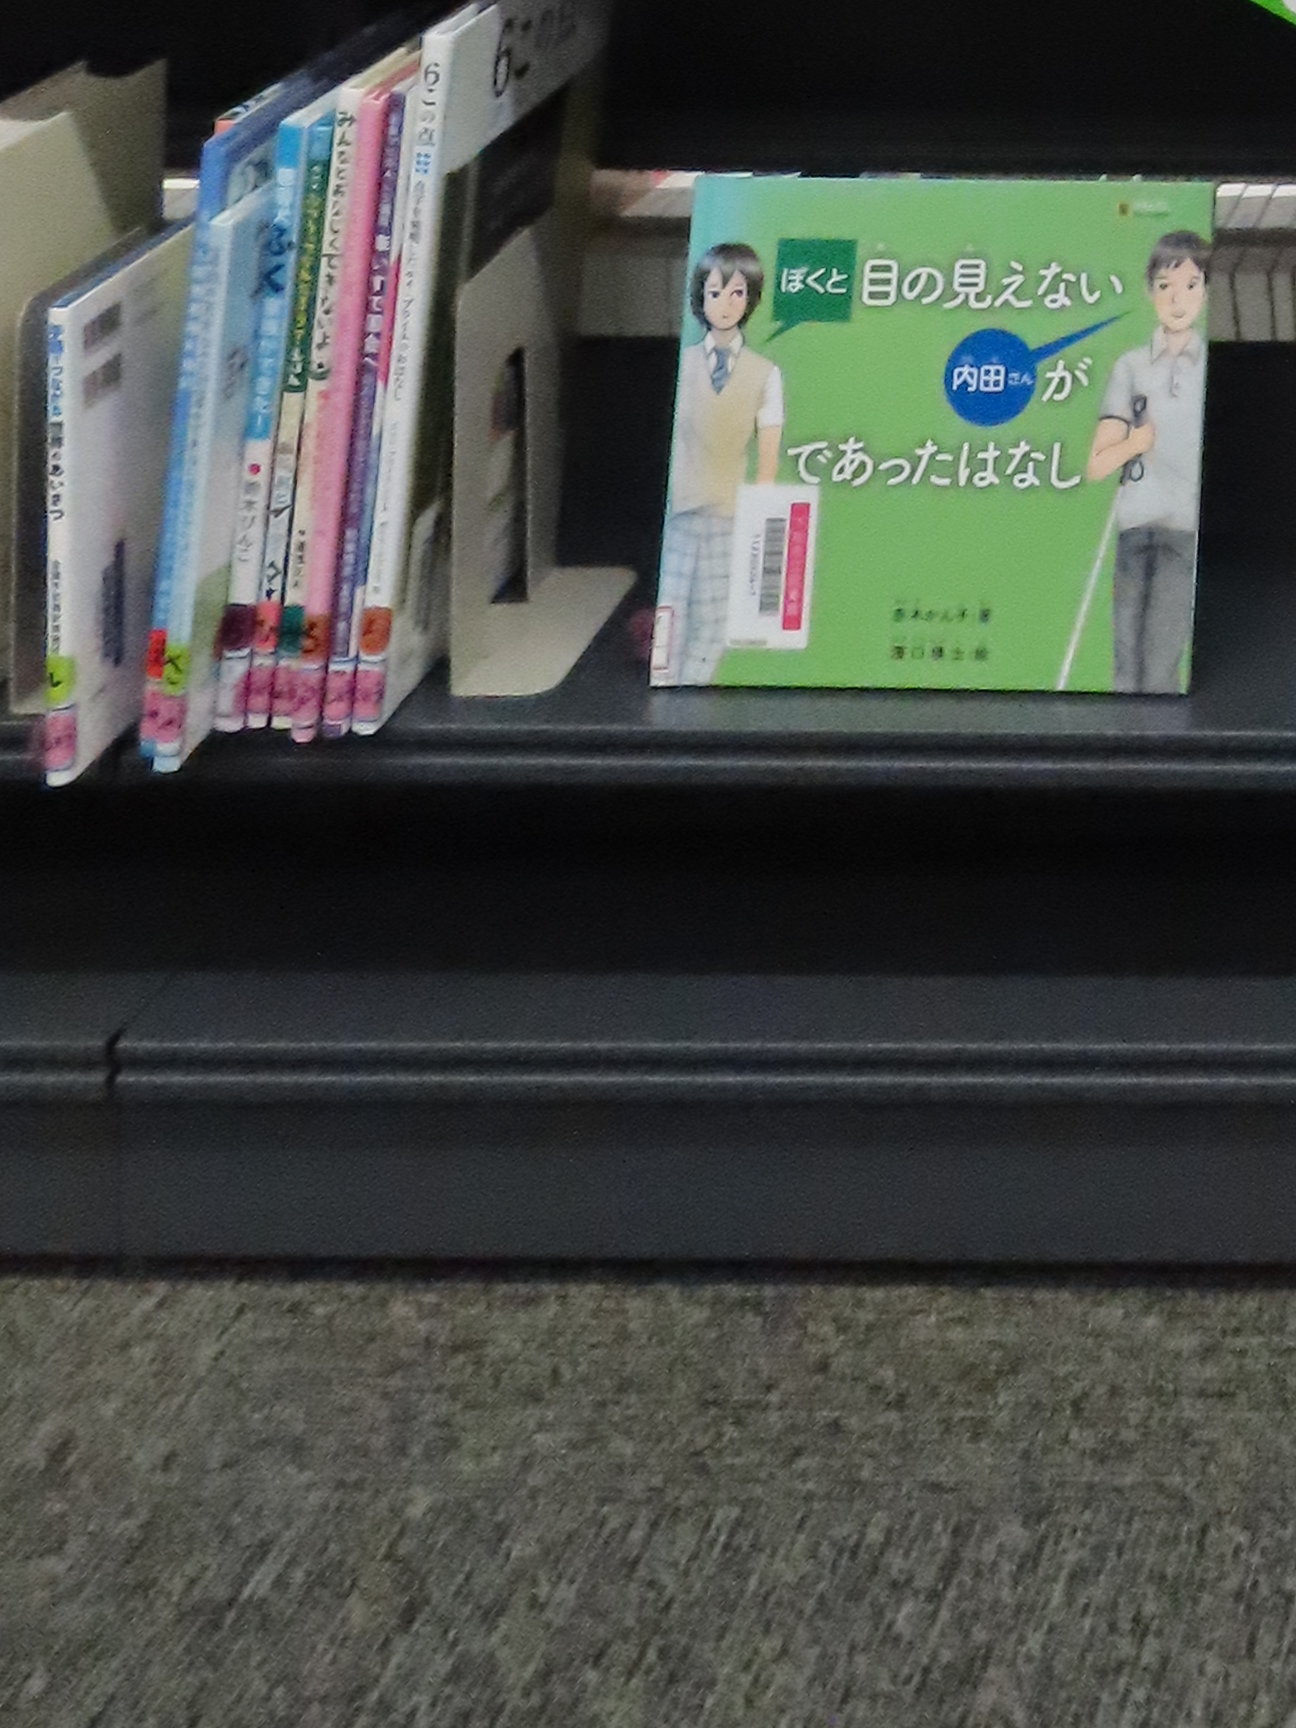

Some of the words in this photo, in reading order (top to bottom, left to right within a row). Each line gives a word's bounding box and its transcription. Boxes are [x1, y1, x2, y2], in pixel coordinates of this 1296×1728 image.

[780, 266, 849, 295] ぼくと
[861, 257, 1126, 310] 目の見えない
[951, 362, 1035, 395] 内田さん
[1041, 358, 1092, 404] が
[786, 436, 1083, 491] であったはなし
